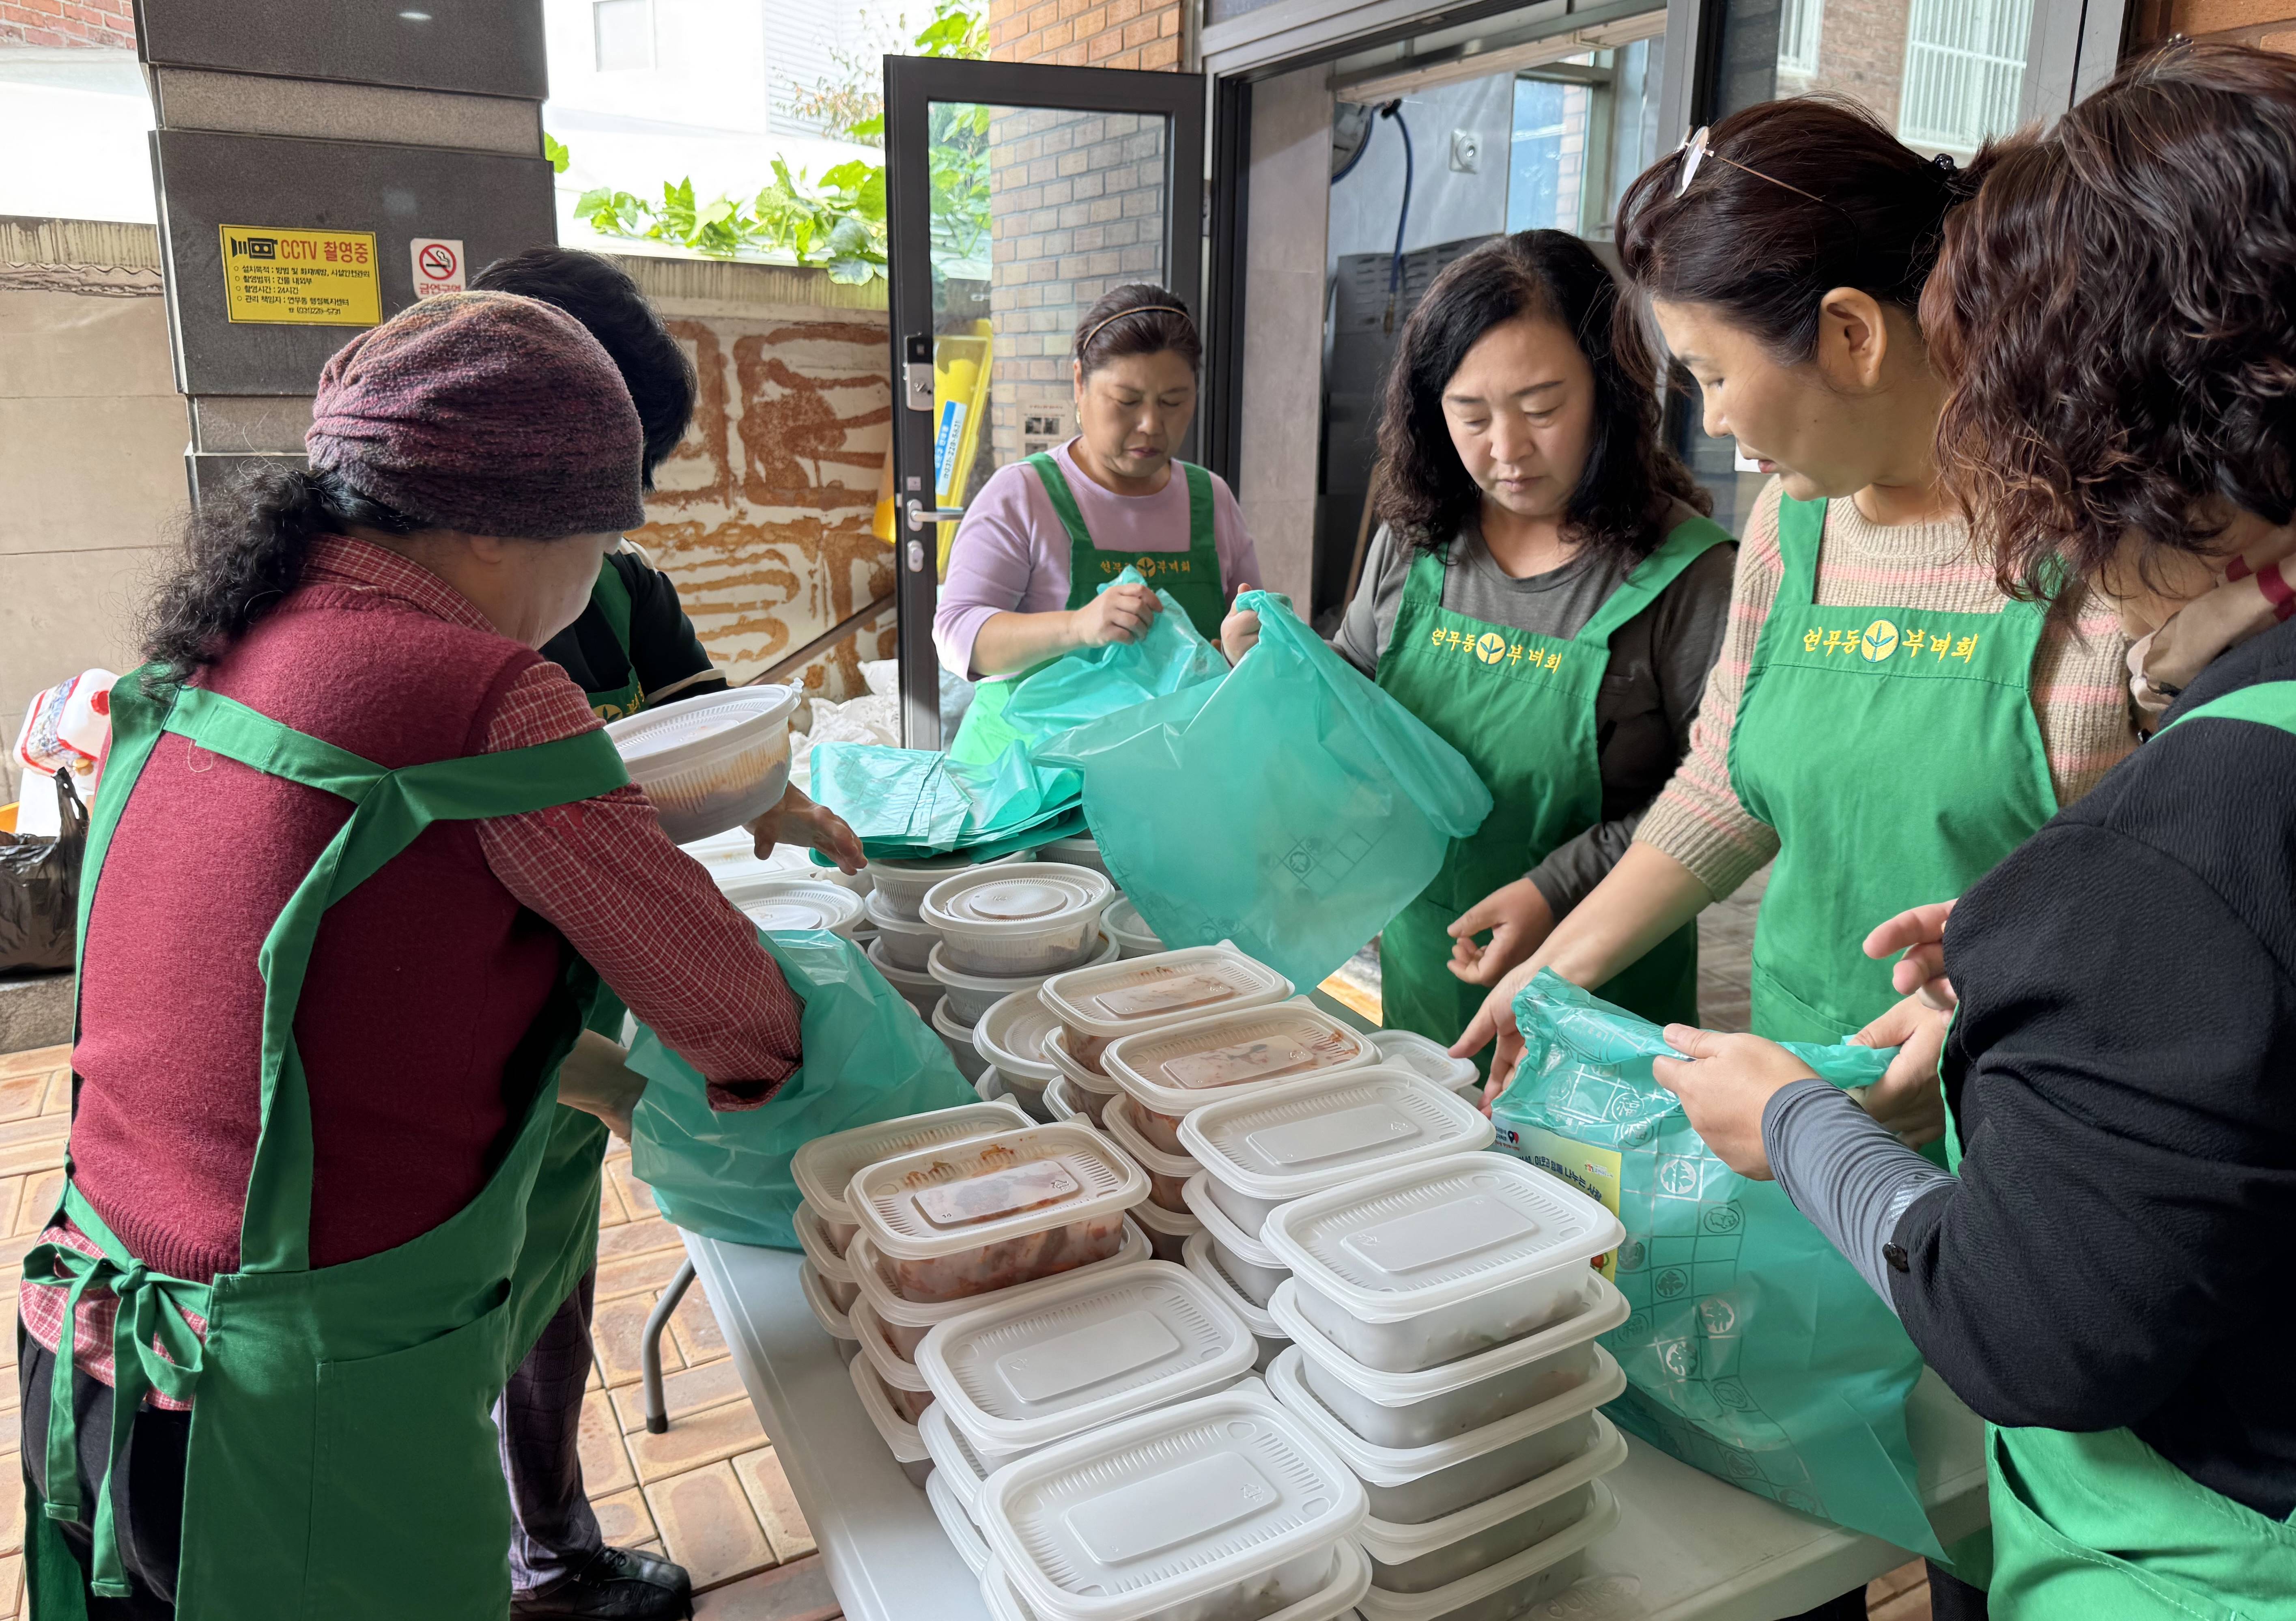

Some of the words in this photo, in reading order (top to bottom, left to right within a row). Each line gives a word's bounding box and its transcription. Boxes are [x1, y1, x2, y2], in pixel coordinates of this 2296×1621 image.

[281, 239, 317, 260] CCTV
[324, 241, 368, 264] 촬영중
[242, 266, 269, 274] 설치목적
[243, 276, 270, 284] 촬영범위
[245, 285, 271, 294] 촬영시간
[245, 295, 259, 303] 관리
[1431, 626, 1476, 653] 연무동
[1506, 644, 1562, 674] 부녀회
[1803, 626, 1860, 657] 연무동
[1902, 629, 1978, 663] 부녀회
[1565, 1167, 1586, 1188] 나누는
